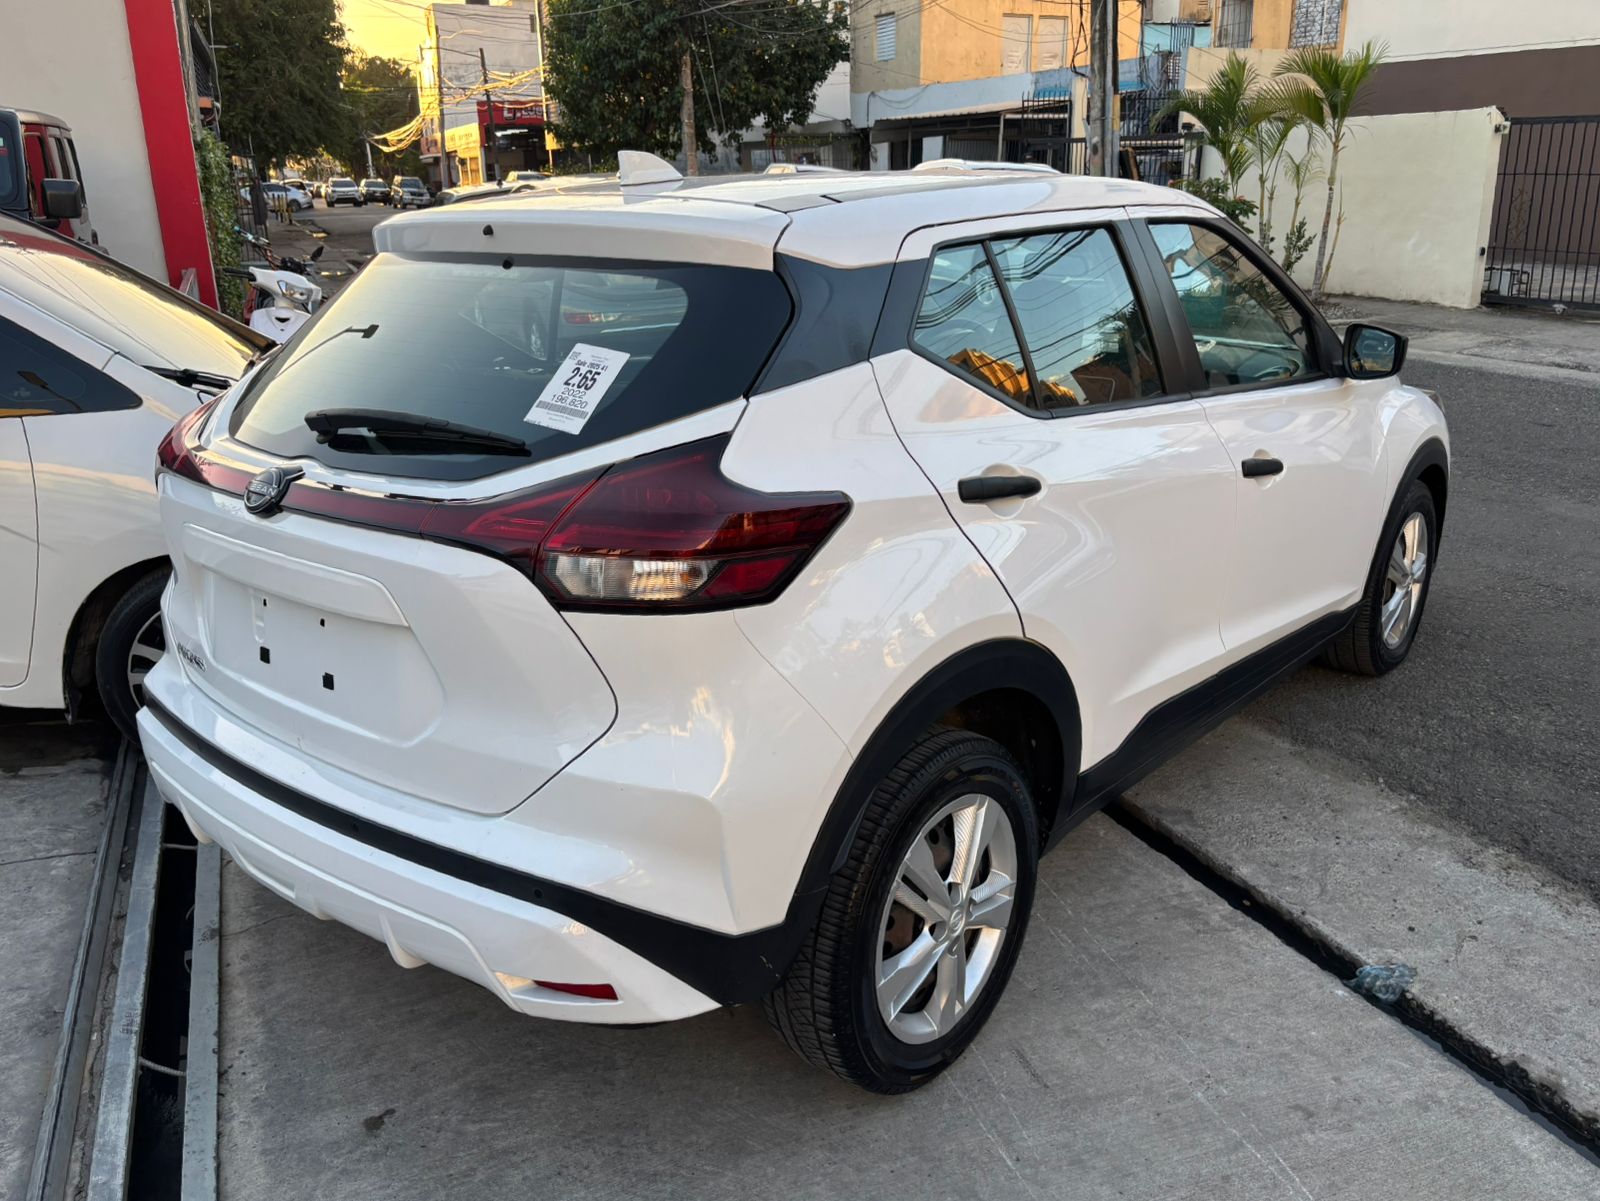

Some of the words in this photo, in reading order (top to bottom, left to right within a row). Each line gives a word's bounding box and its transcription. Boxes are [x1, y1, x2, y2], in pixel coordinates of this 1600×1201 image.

[563, 367, 601, 391] 2:65
[561, 387, 587, 399] 2022
[551, 394, 588, 409] 196.820
